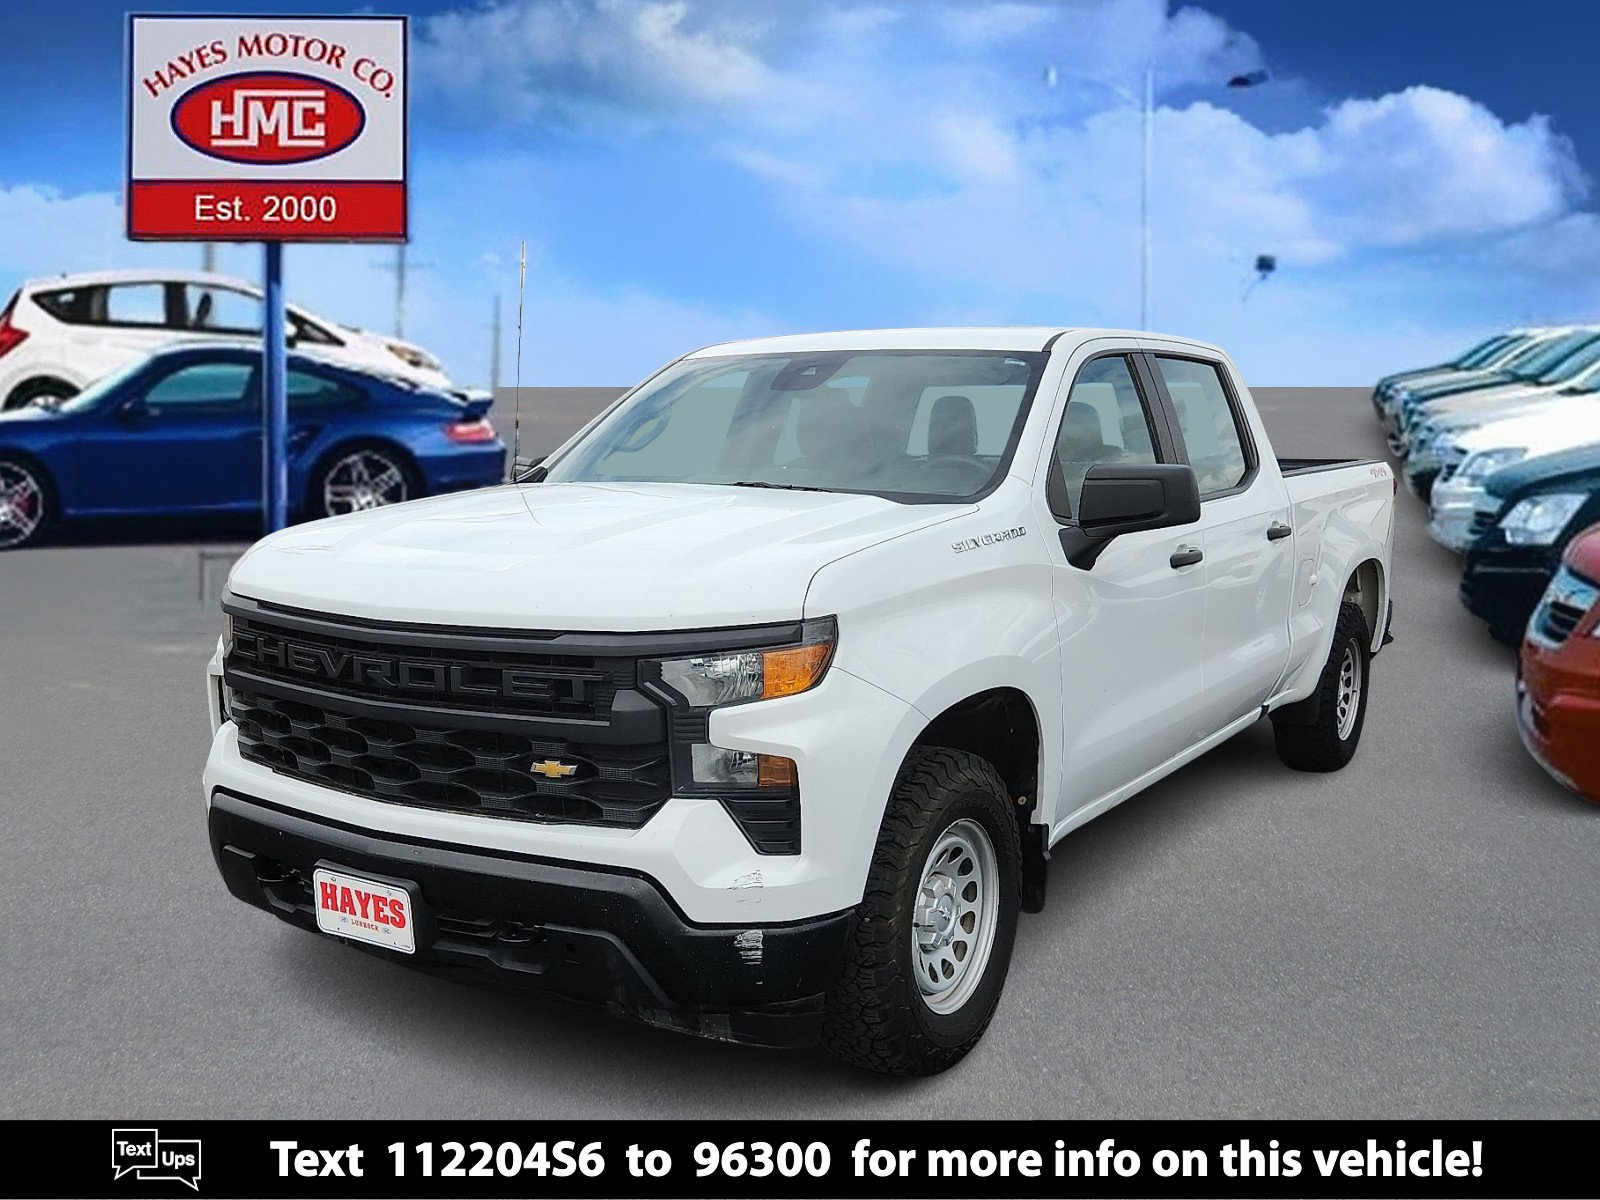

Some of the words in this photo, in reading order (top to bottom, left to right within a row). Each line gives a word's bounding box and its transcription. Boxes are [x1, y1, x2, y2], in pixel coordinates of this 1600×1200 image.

[142, 40, 228, 98] HAYES
[237, 32, 346, 70] MOTOR
[352, 57, 395, 99] CO.
[210, 88, 327, 148] HMC
[194, 194, 250, 222] Est.
[262, 195, 337, 222] 2000
[951, 526, 1027, 554] SILVERADO
[232, 630, 609, 703] CHEVROLET
[319, 881, 406, 929] HAYES
